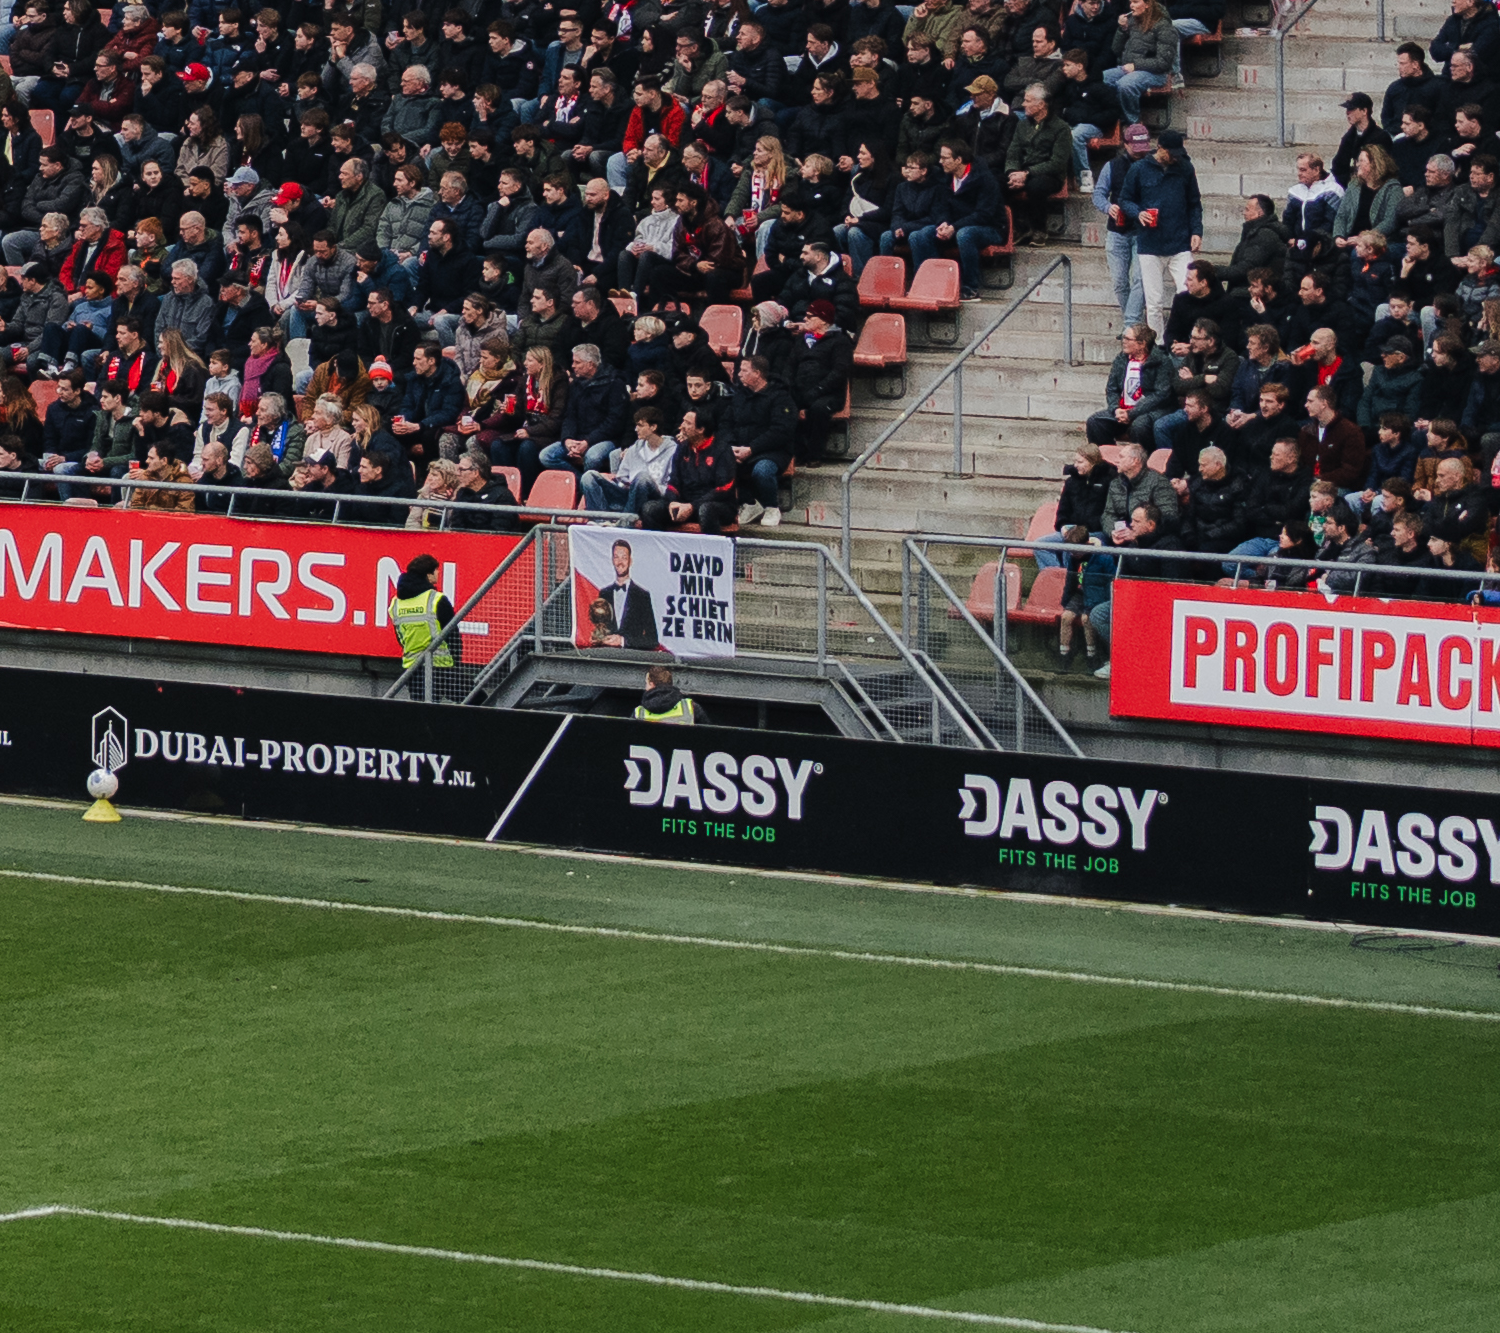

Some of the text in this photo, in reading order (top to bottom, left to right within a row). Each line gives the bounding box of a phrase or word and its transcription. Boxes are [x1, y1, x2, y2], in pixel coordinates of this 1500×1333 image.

[669, 551, 725, 578] DAVID
[398, 605, 425, 616] STEWARD
[665, 595, 729, 622] SCHIET
[662, 616, 734, 644] ZE ERIN
[134, 725, 475, 789] DUBAI-PROPERTY.NL
[662, 817, 777, 844] FITS THE JOB
[998, 847, 1120, 875] FITS THE JOB
[1350, 881, 1477, 909] FITS THE JOB
